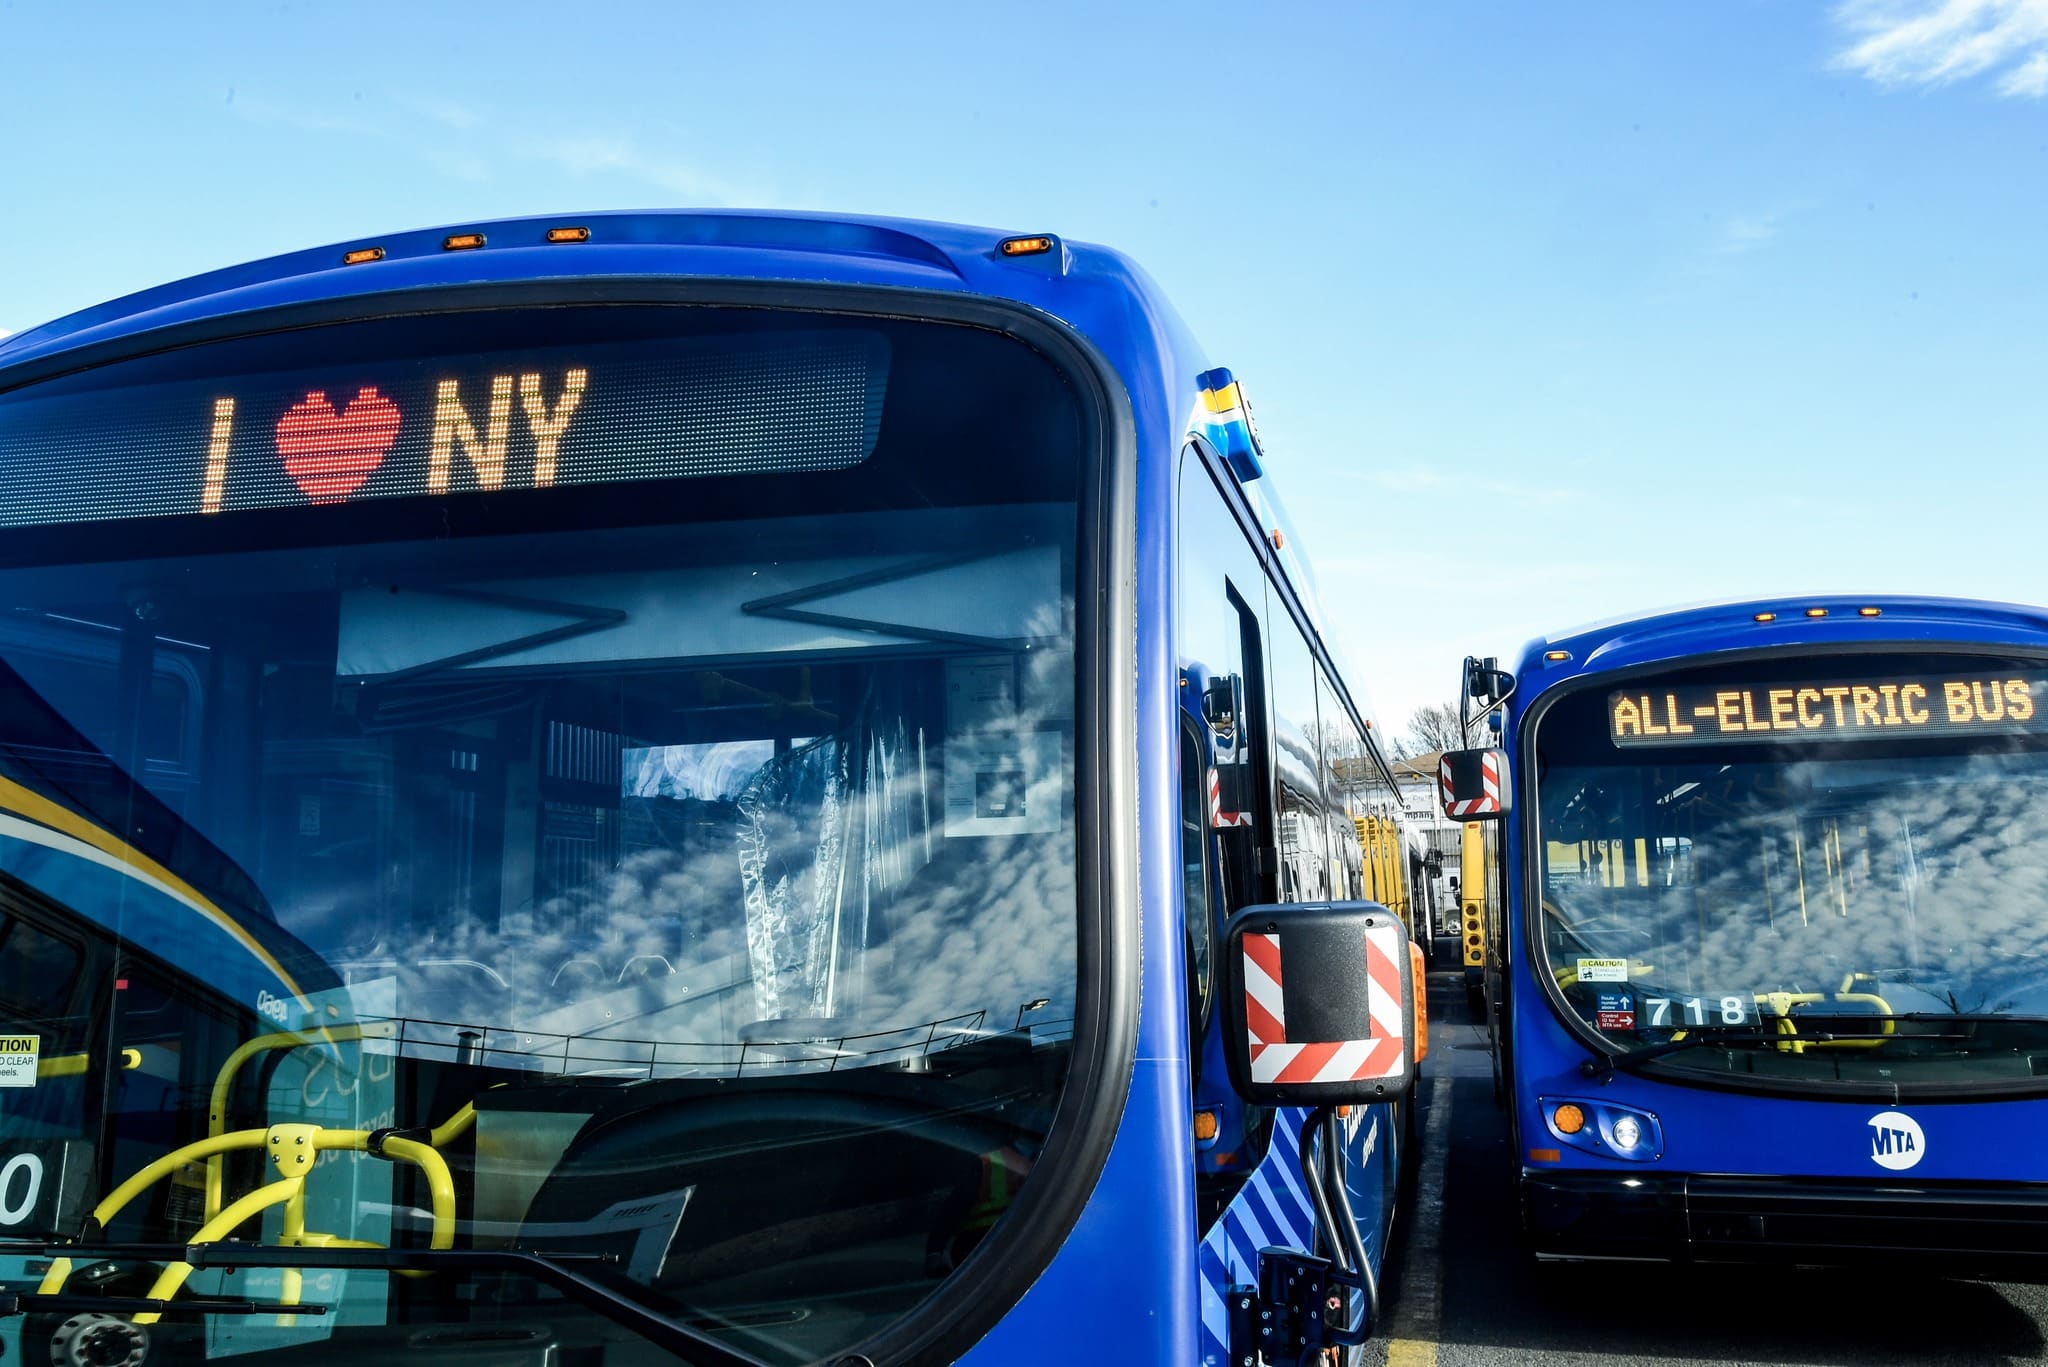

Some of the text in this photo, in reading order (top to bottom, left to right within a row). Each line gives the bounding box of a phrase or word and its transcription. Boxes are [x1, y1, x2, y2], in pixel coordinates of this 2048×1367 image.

[203, 368, 587, 513] I NY
[1613, 679, 2035, 736] ALL-ELECTRIC BUS
[6, 1056, 34, 1065] CLEAR
